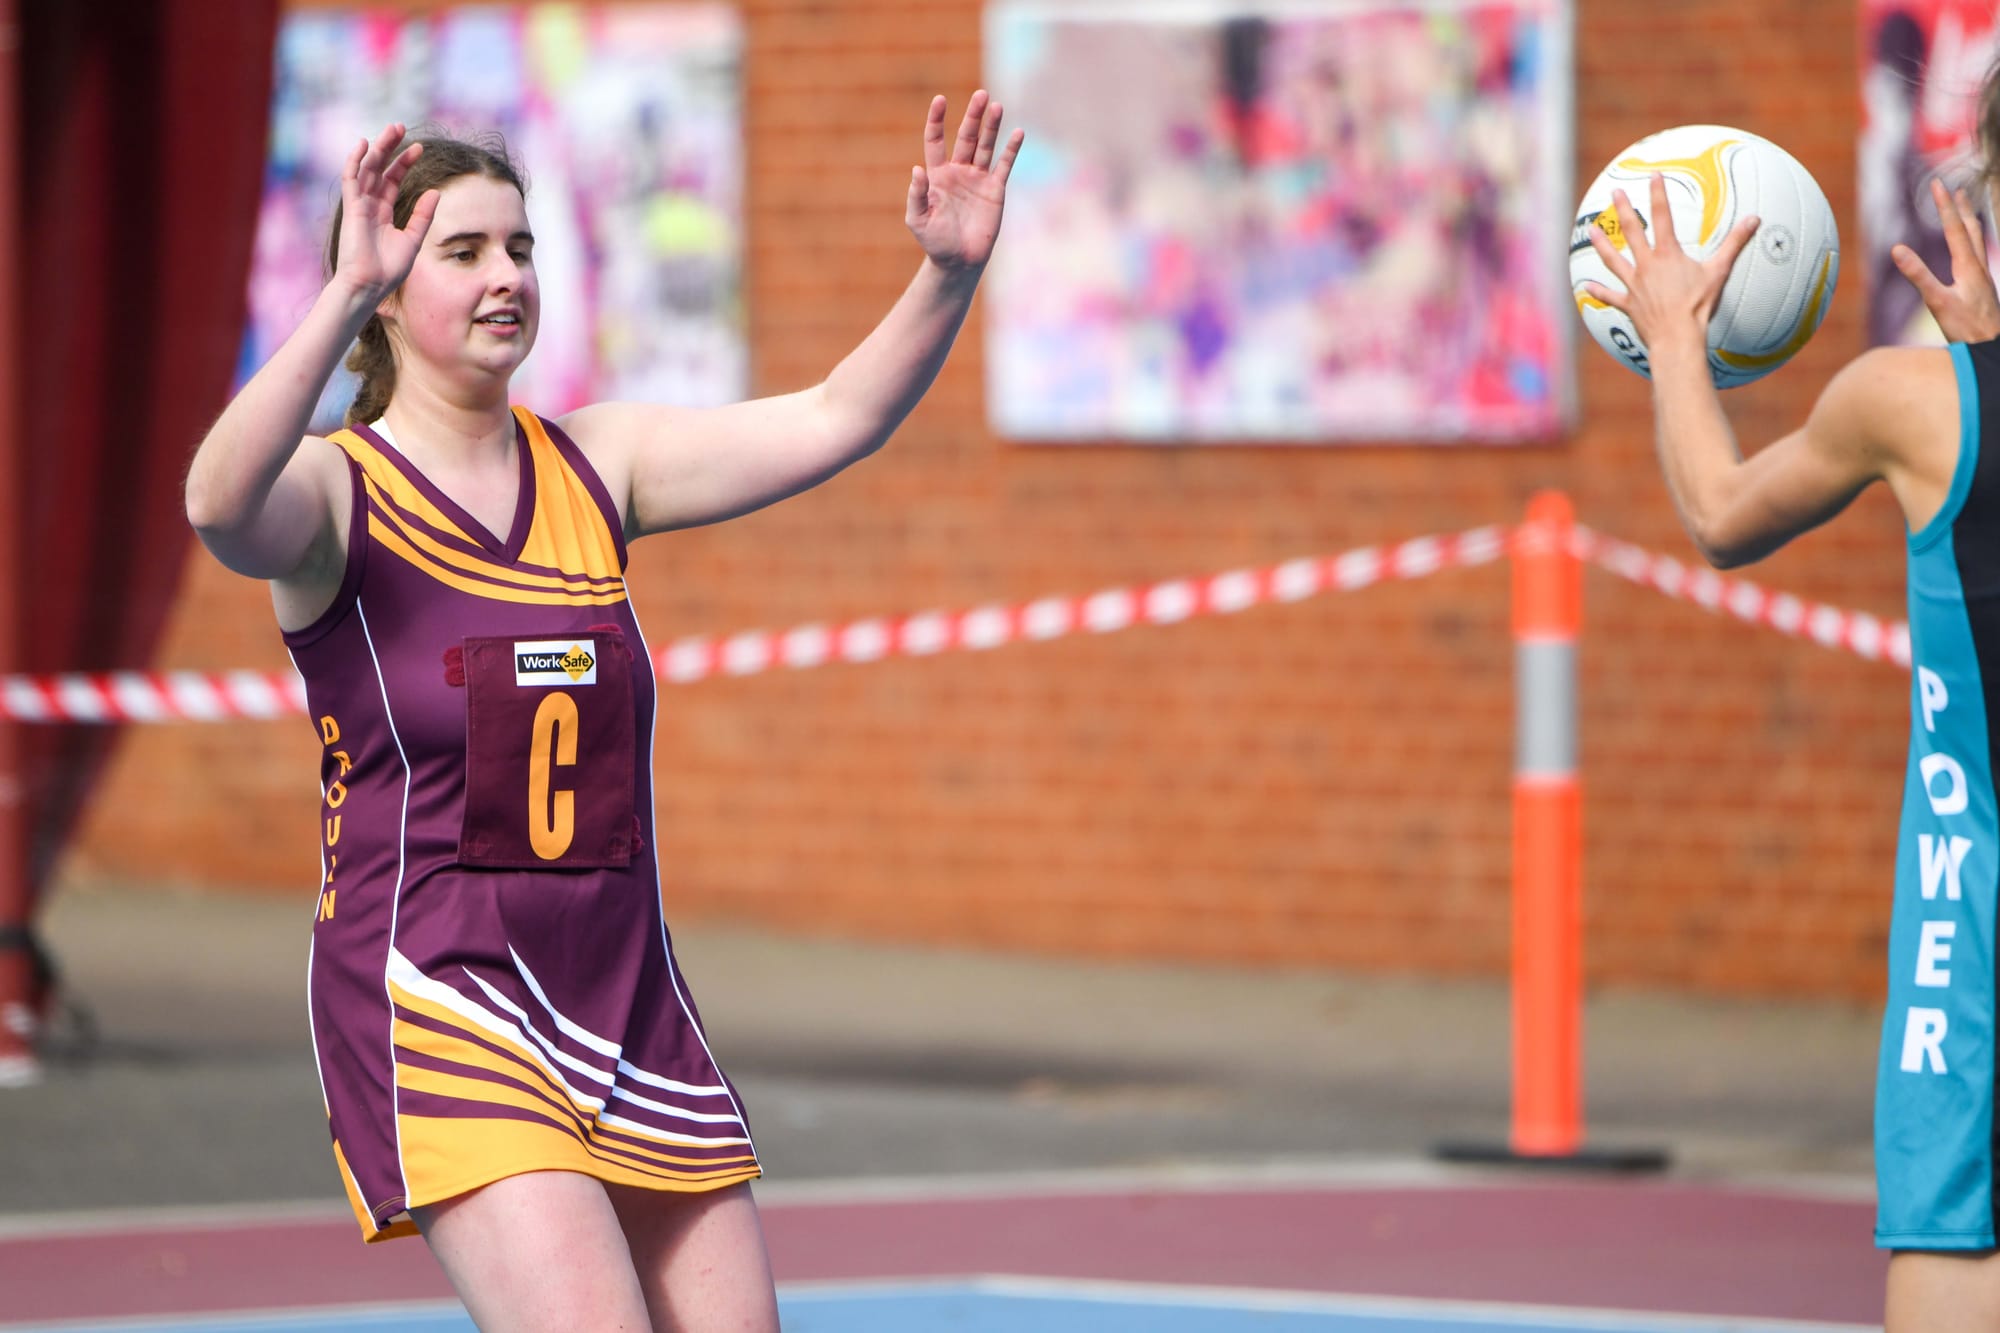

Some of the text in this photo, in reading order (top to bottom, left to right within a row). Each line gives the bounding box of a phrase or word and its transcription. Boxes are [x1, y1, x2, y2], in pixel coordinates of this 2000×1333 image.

[522, 653, 590, 670] WorkSafe
[319, 715, 353, 922] DROUIN
[528, 691, 579, 860] C
[1900, 665, 1973, 1075] POWER
